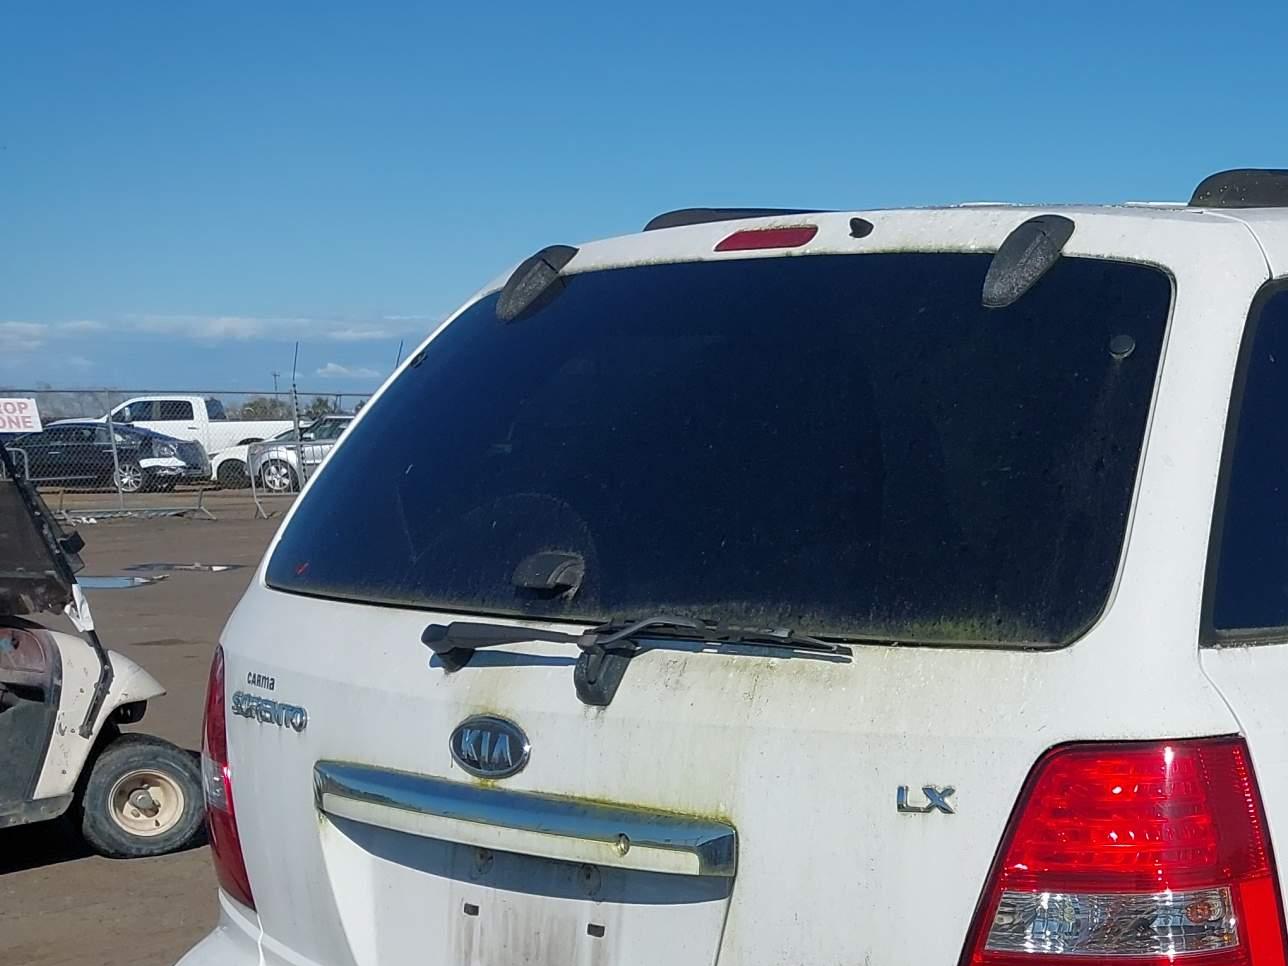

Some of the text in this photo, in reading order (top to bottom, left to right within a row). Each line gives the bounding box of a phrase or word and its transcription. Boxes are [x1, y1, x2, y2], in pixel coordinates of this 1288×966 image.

[0, 401, 28, 414] OP
[232, 691, 308, 732] SORENTO
[461, 729, 512, 767] KIA
[897, 785, 955, 814] LX
